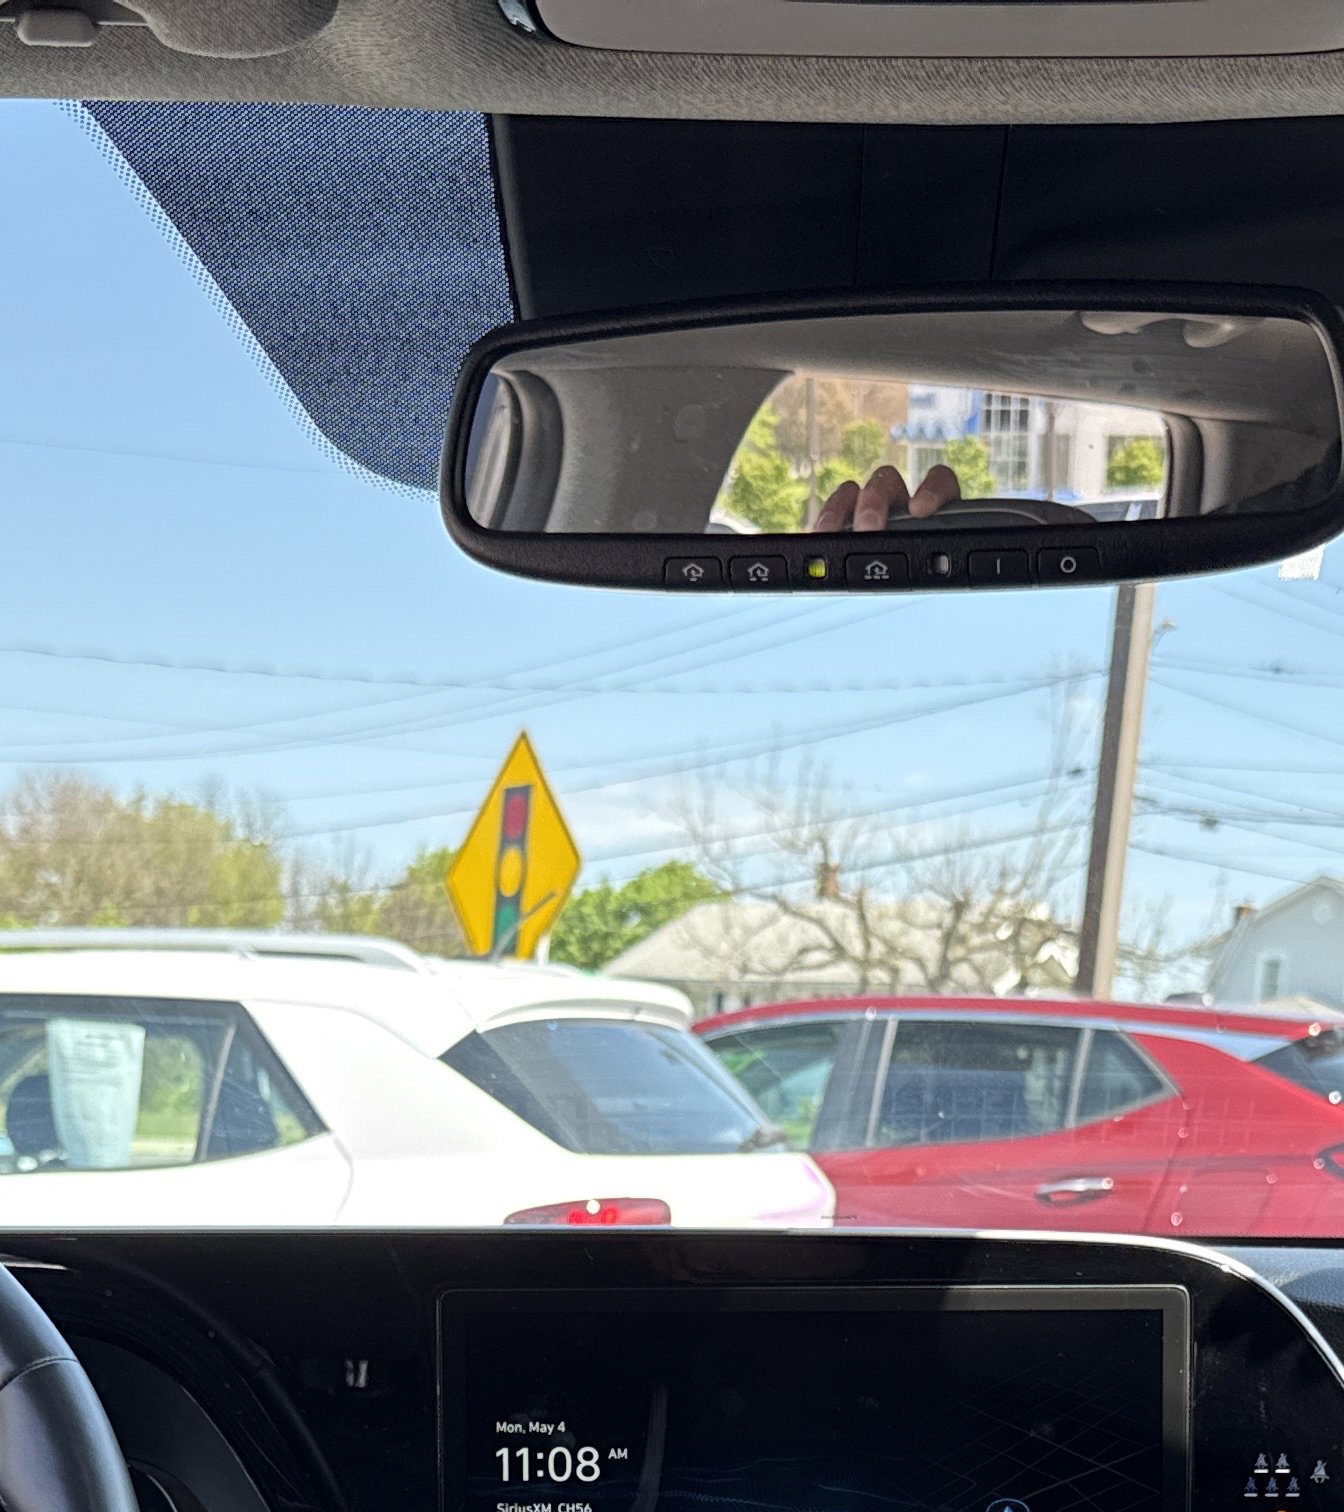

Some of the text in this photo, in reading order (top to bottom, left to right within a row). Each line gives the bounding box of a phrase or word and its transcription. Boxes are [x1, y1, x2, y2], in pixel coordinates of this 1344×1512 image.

[495, 1421, 566, 1436] Mon, May 4
[495, 1446, 629, 1482] 11:08 AM
